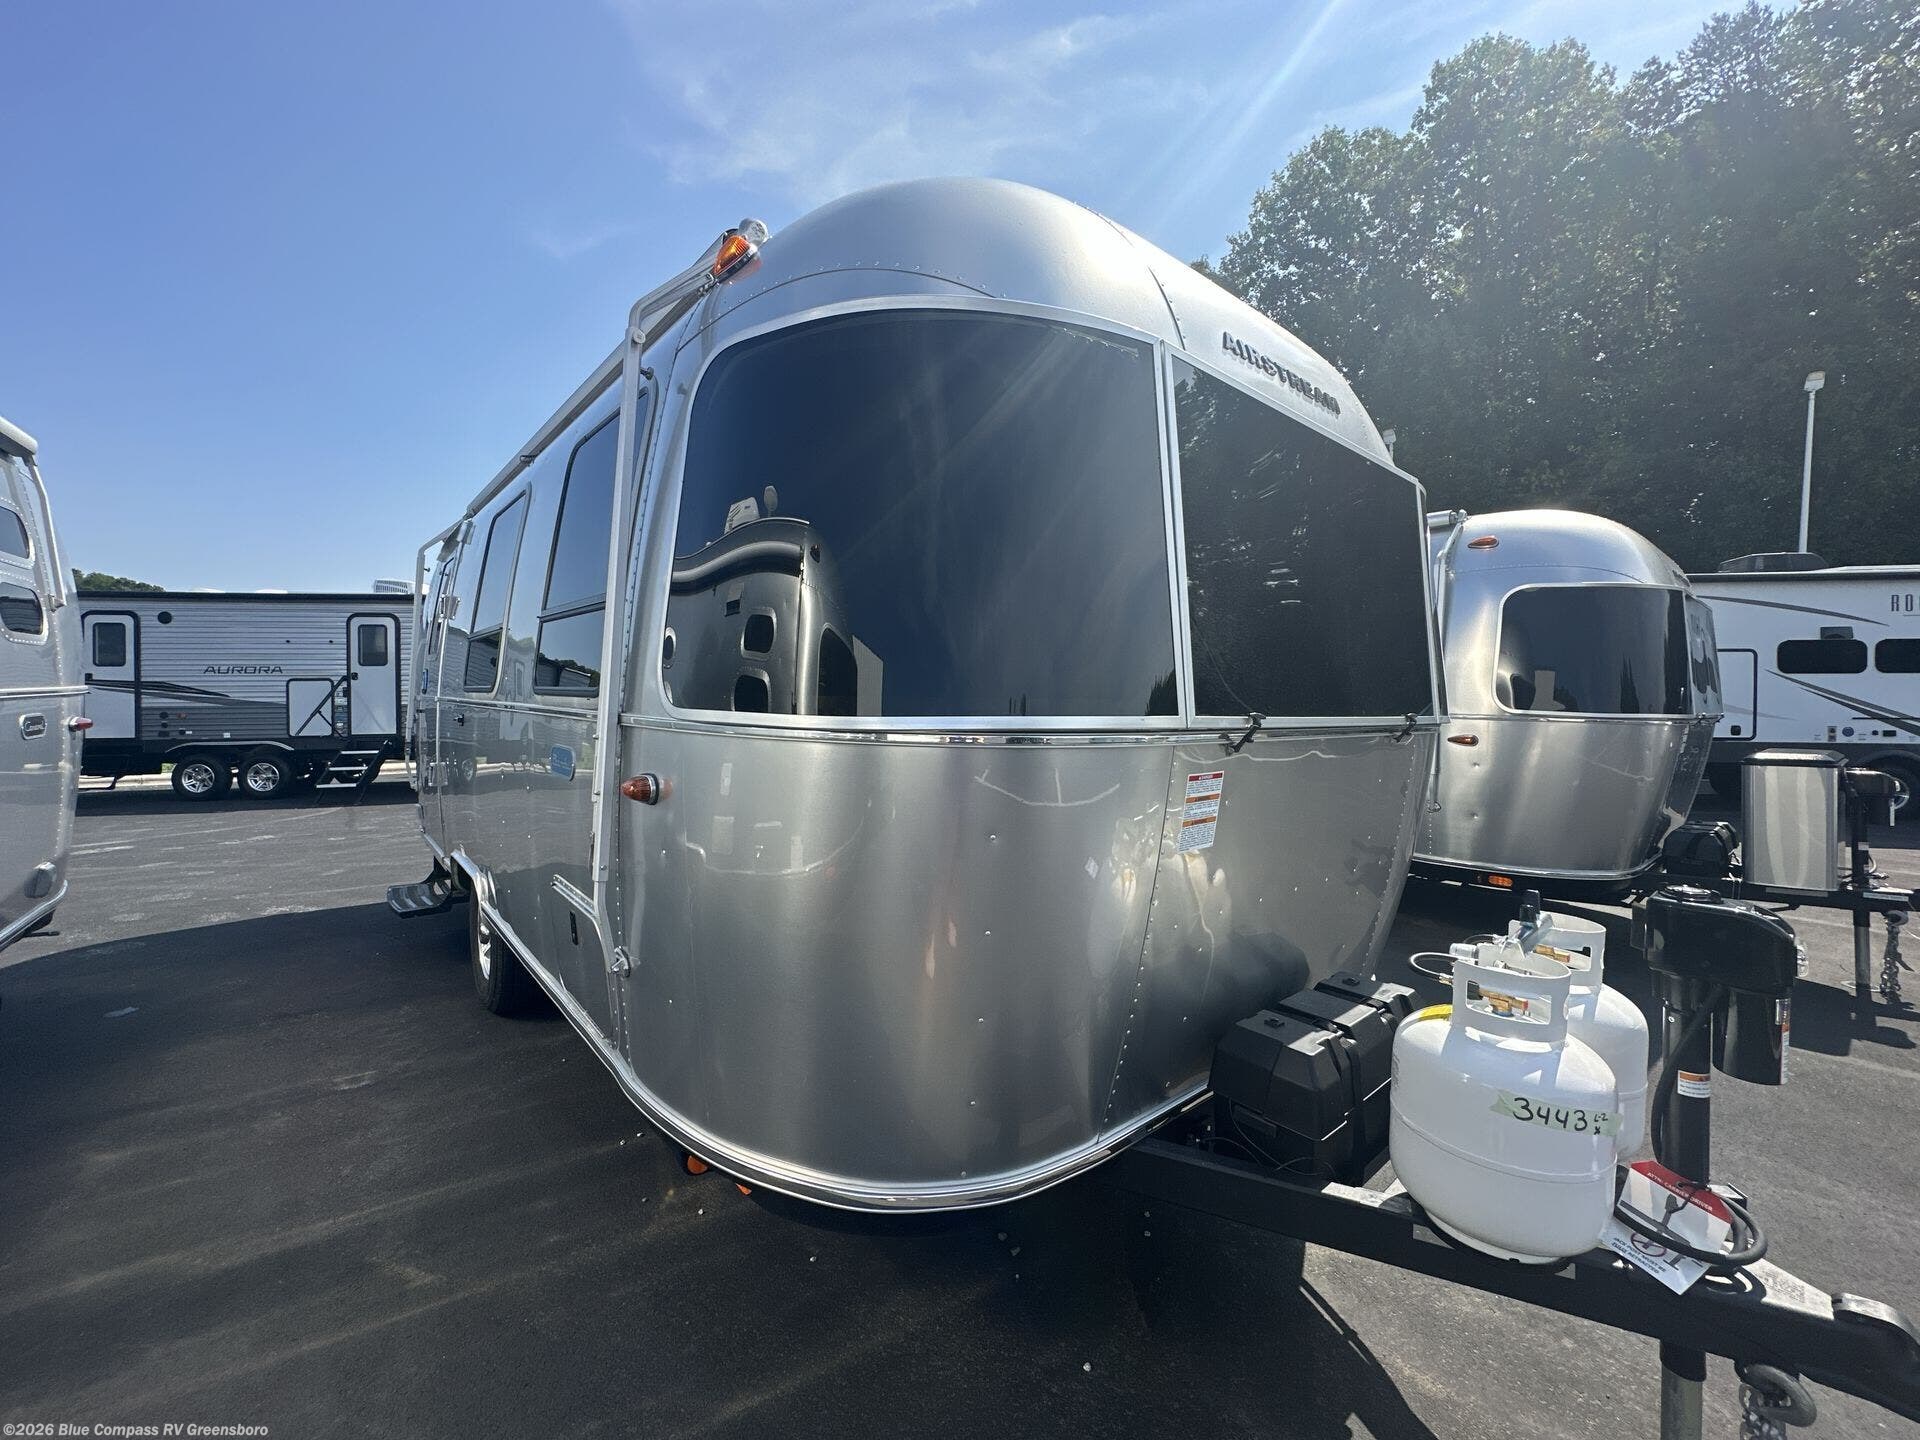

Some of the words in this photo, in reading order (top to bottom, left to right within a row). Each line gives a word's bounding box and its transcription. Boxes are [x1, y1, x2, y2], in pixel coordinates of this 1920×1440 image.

[1222, 331, 1341, 415] AIRSTREAM
[1891, 594, 1920, 612] RO
[203, 666, 283, 674] AURORA
[1512, 1097, 1588, 1132] 3443
